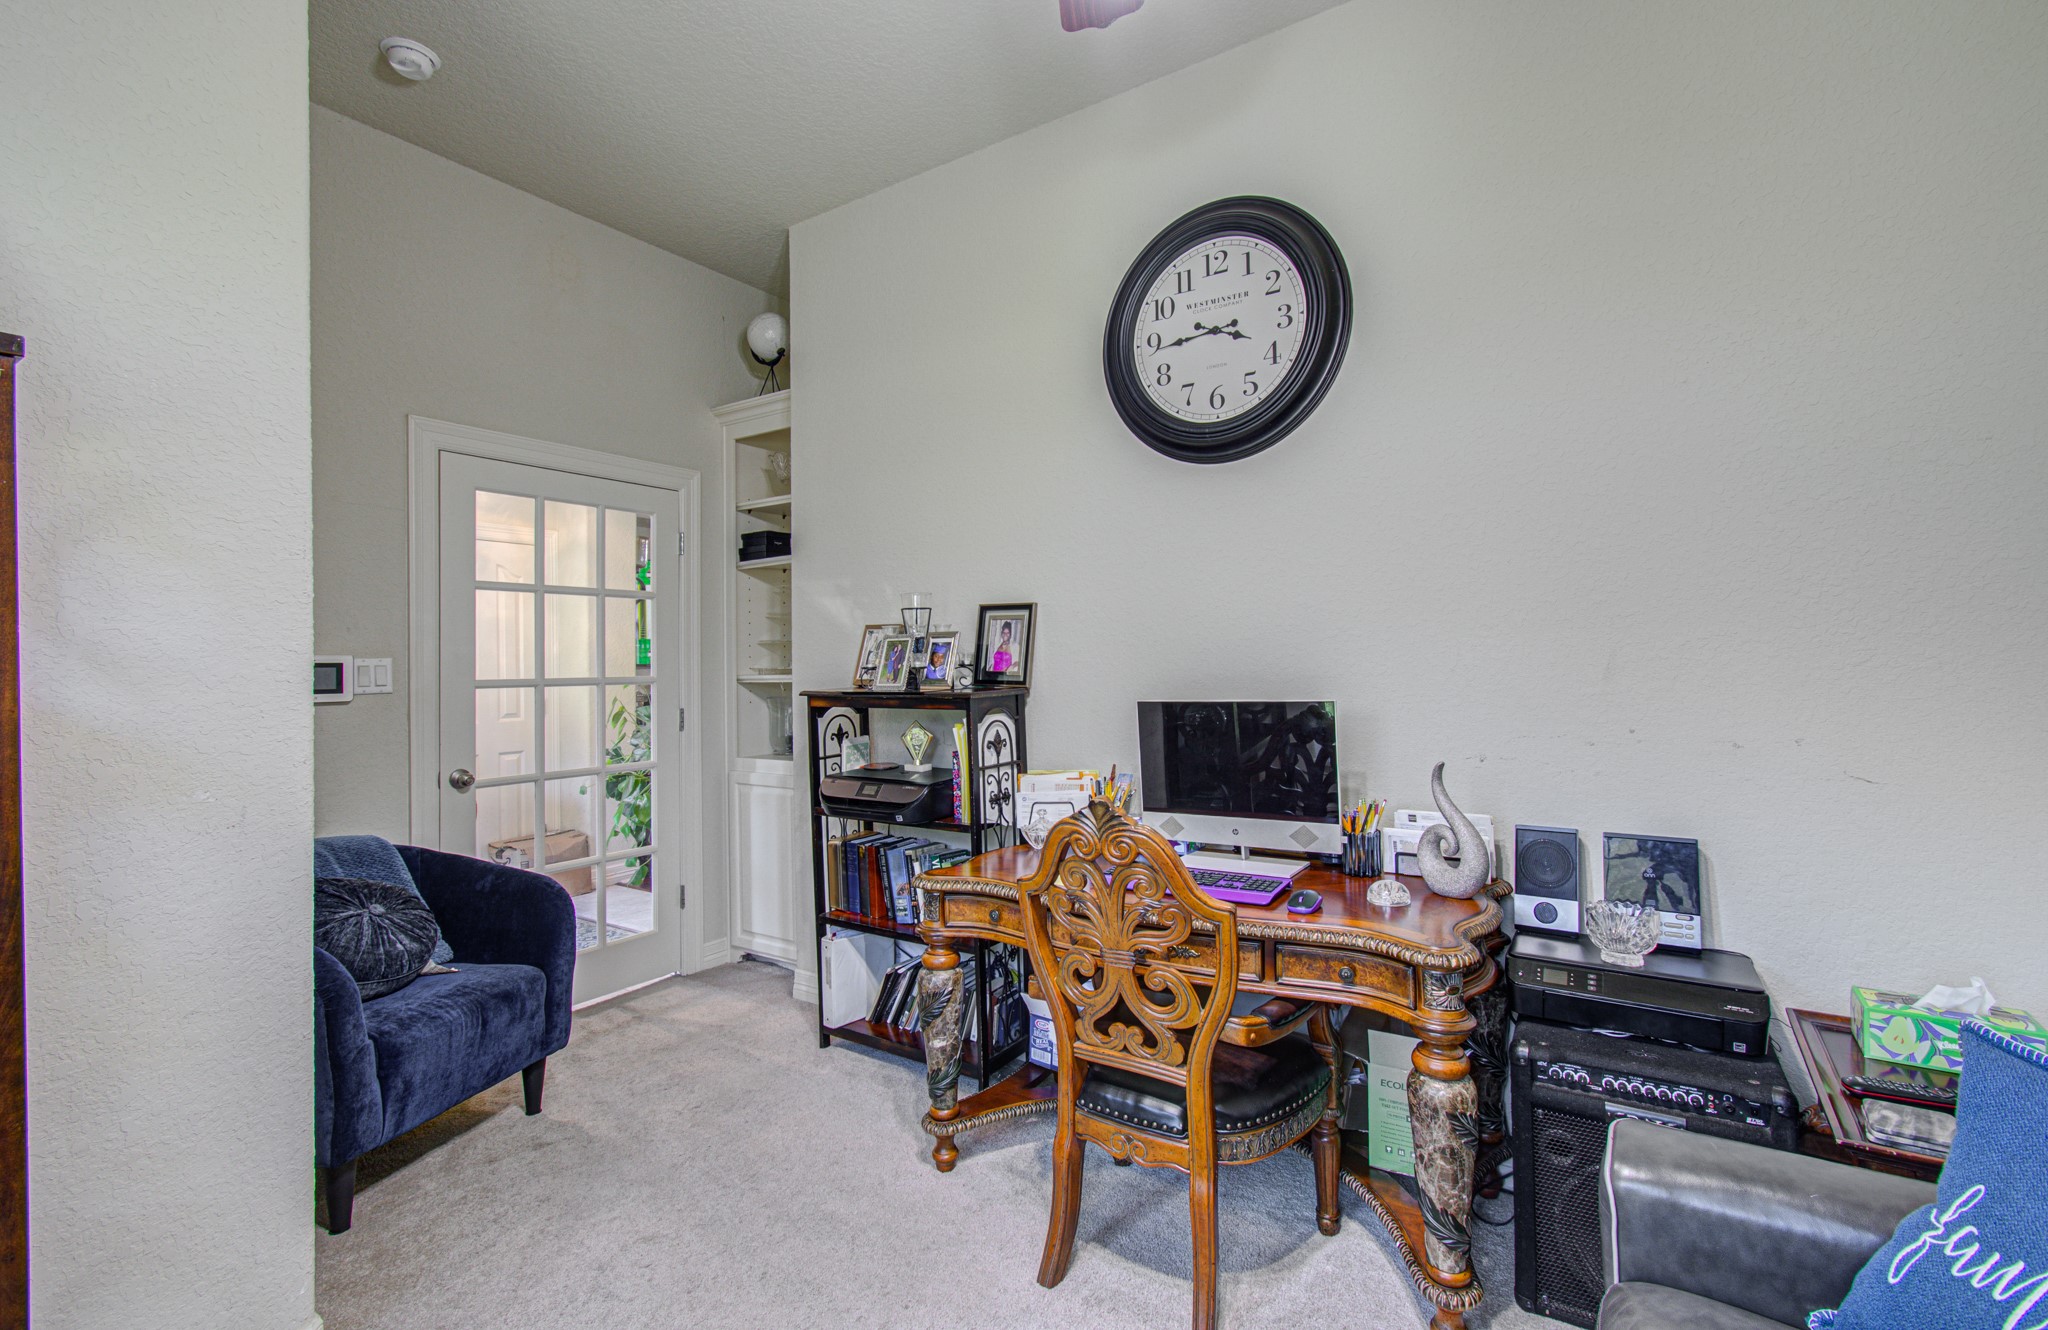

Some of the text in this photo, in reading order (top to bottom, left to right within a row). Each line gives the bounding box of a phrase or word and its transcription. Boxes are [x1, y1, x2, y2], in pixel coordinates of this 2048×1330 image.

[1201, 250, 1229, 278] 12
[1241, 251, 1255, 276] 1
[1173, 269, 1196, 295] 11
[1264, 269, 1281, 296] 2
[1151, 296, 1175, 322] 10
[1186, 291, 1249, 310] WESTMINSTER
[1193, 300, 1243, 315] CLOCK COMPANY
[1276, 304, 1293, 329] 3
[1146, 332, 1162, 357] 9
[1263, 340, 1282, 365] 4
[1156, 363, 1171, 387] 8
[1243, 370, 1259, 396] 5
[1180, 382, 1195, 406] 7
[1209, 384, 1226, 410] 6
